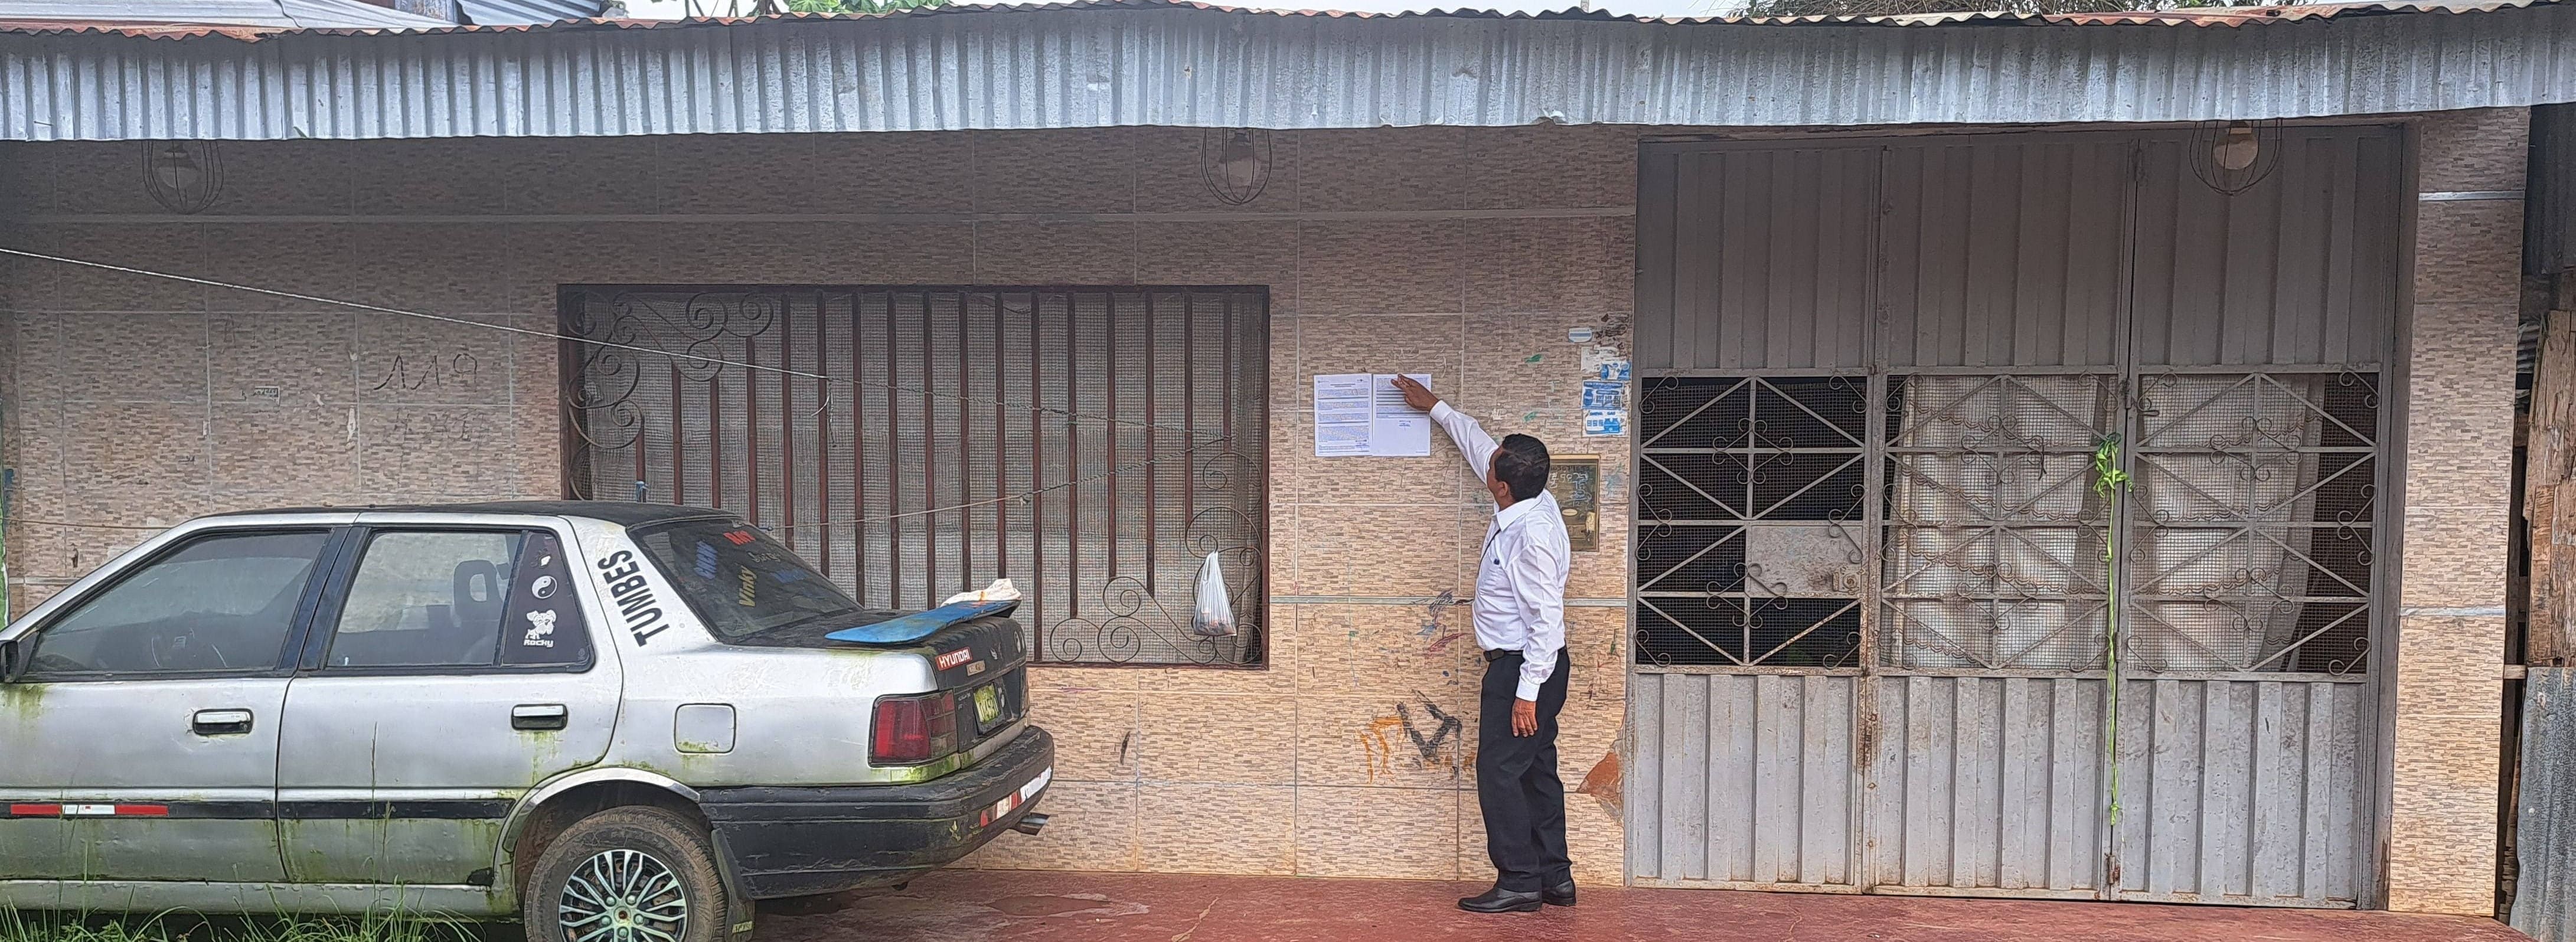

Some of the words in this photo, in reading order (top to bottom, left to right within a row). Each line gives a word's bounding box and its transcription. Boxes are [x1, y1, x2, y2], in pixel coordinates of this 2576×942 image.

[598, 550, 670, 647] TUMBES
[738, 565, 758, 607] Vinky
[938, 649, 971, 668] HYUNDAI
